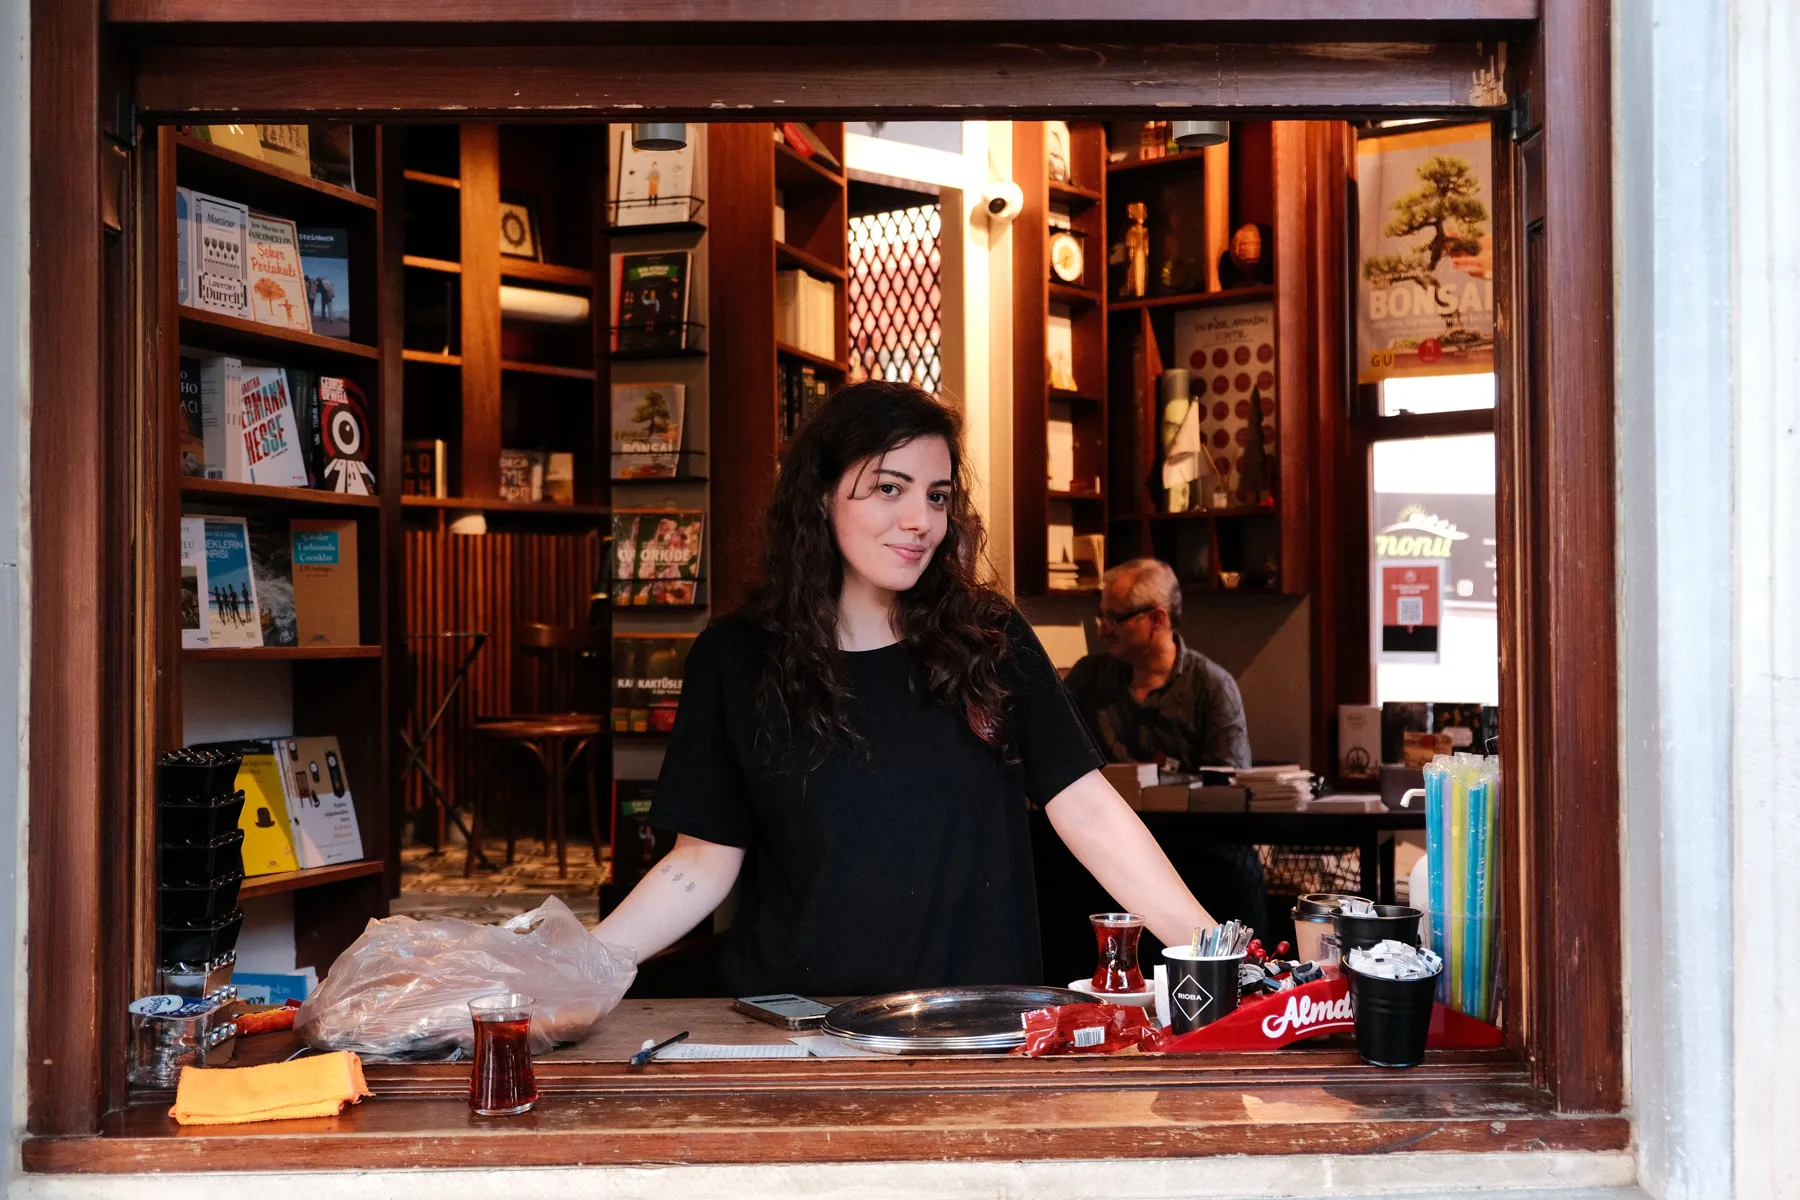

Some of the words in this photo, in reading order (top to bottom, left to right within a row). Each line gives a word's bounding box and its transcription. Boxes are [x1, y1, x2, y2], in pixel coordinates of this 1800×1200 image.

[206, 213, 236, 228] Monsieur
[298, 233, 335, 242] Steinbeck
[206, 287, 240, 305] Durrell
[1370, 281, 1493, 320] BONSAI
[244, 415, 287, 467] HESSE
[637, 676, 684, 689] KAKTÜSLE
[1177, 992, 1203, 1001] RIOBA
[1262, 991, 1354, 1039] Almd
